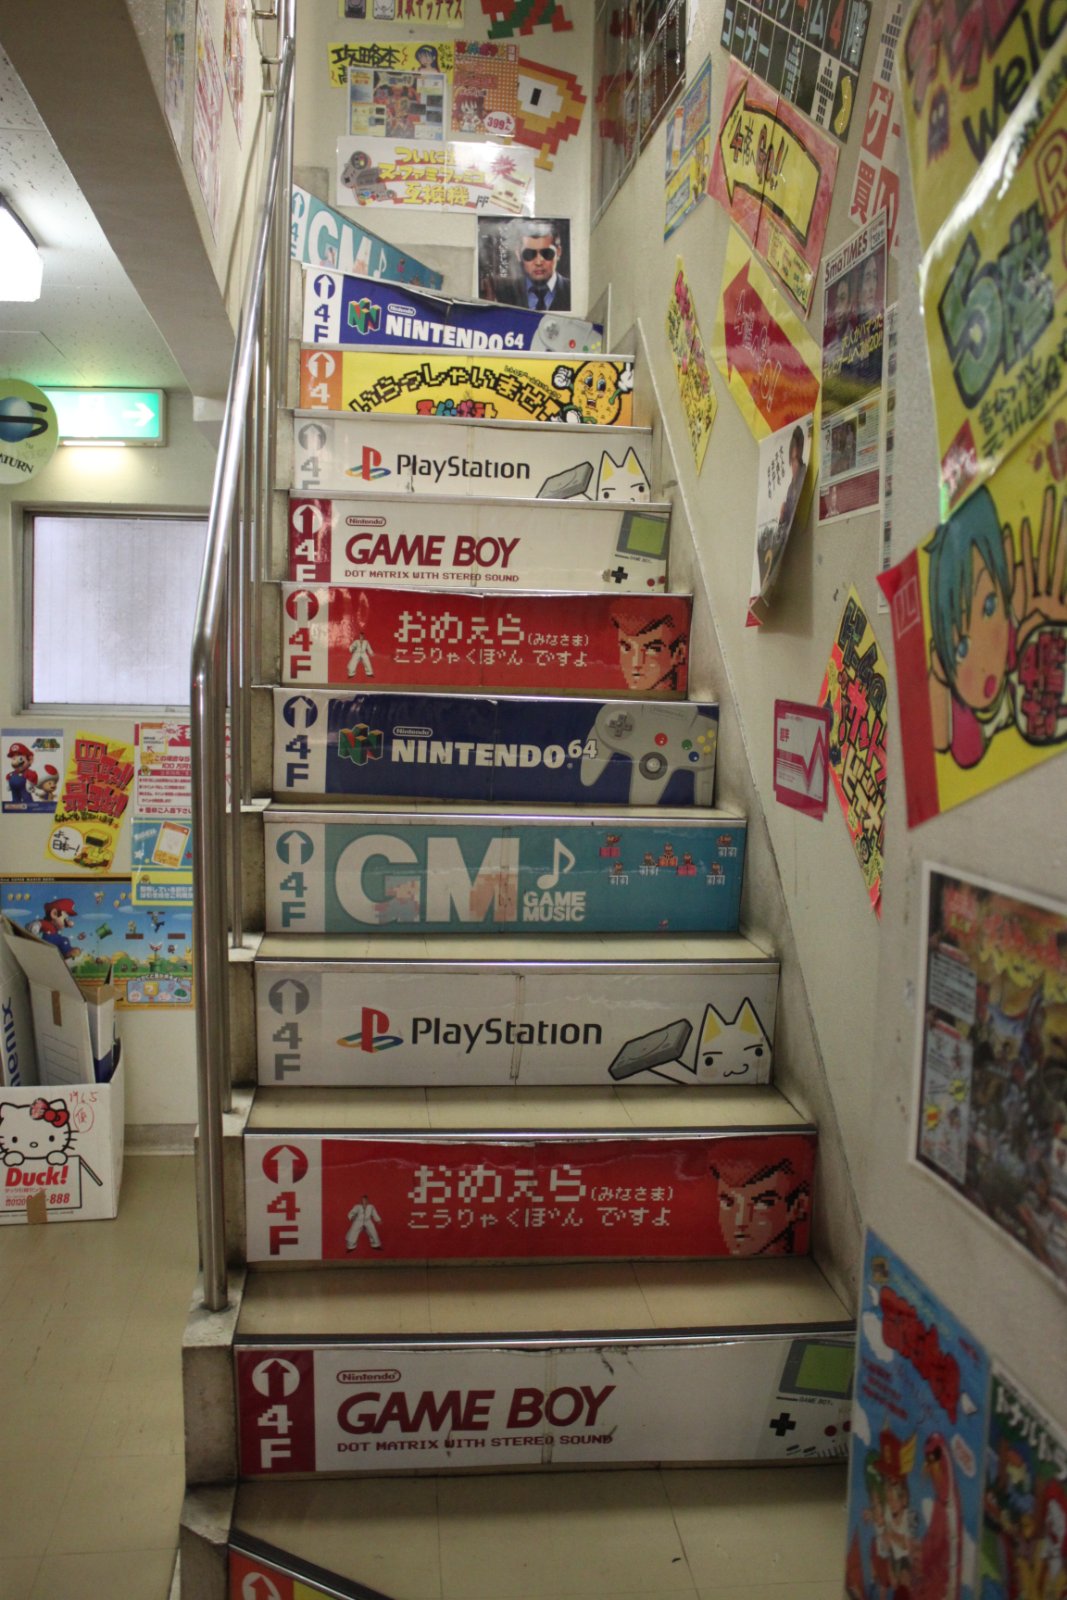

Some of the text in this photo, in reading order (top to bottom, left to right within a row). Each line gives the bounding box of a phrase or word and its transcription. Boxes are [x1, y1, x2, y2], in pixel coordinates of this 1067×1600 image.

[313, 304, 331, 343] 4F
[385, 315, 524, 350] NINTENDO 64
[396, 454, 530, 483] PlayStation
[348, 517, 384, 526] Nintendo
[345, 533, 520, 568] GAME BOY
[344, 569, 520, 583] DOT MATRIX WITH STEREO SOUND
[394, 610, 525, 646] おめえら
[289, 628, 313, 680] 4F
[285, 734, 312, 788] 4F
[391, 739, 598, 769] NINTENDO 64
[334, 833, 520, 925] GM
[280, 872, 307, 927] 4F
[523, 890, 586, 907] GAME
[523, 906, 586, 923] MUSIC
[273, 1022, 303, 1081] 4F
[411, 1017, 603, 1054] PlayStation
[5, 1165, 69, 1187] Duck!
[408, 1164, 586, 1204] おめえら
[266, 1192, 301, 1257] 4F
[342, 1372, 397, 1382] Nintendo
[337, 1385, 617, 1434] GAME BOY
[257, 1405, 294, 1469] 4F
[337, 1433, 614, 1452] DOT MATRIX WITH STEREO SOUND
